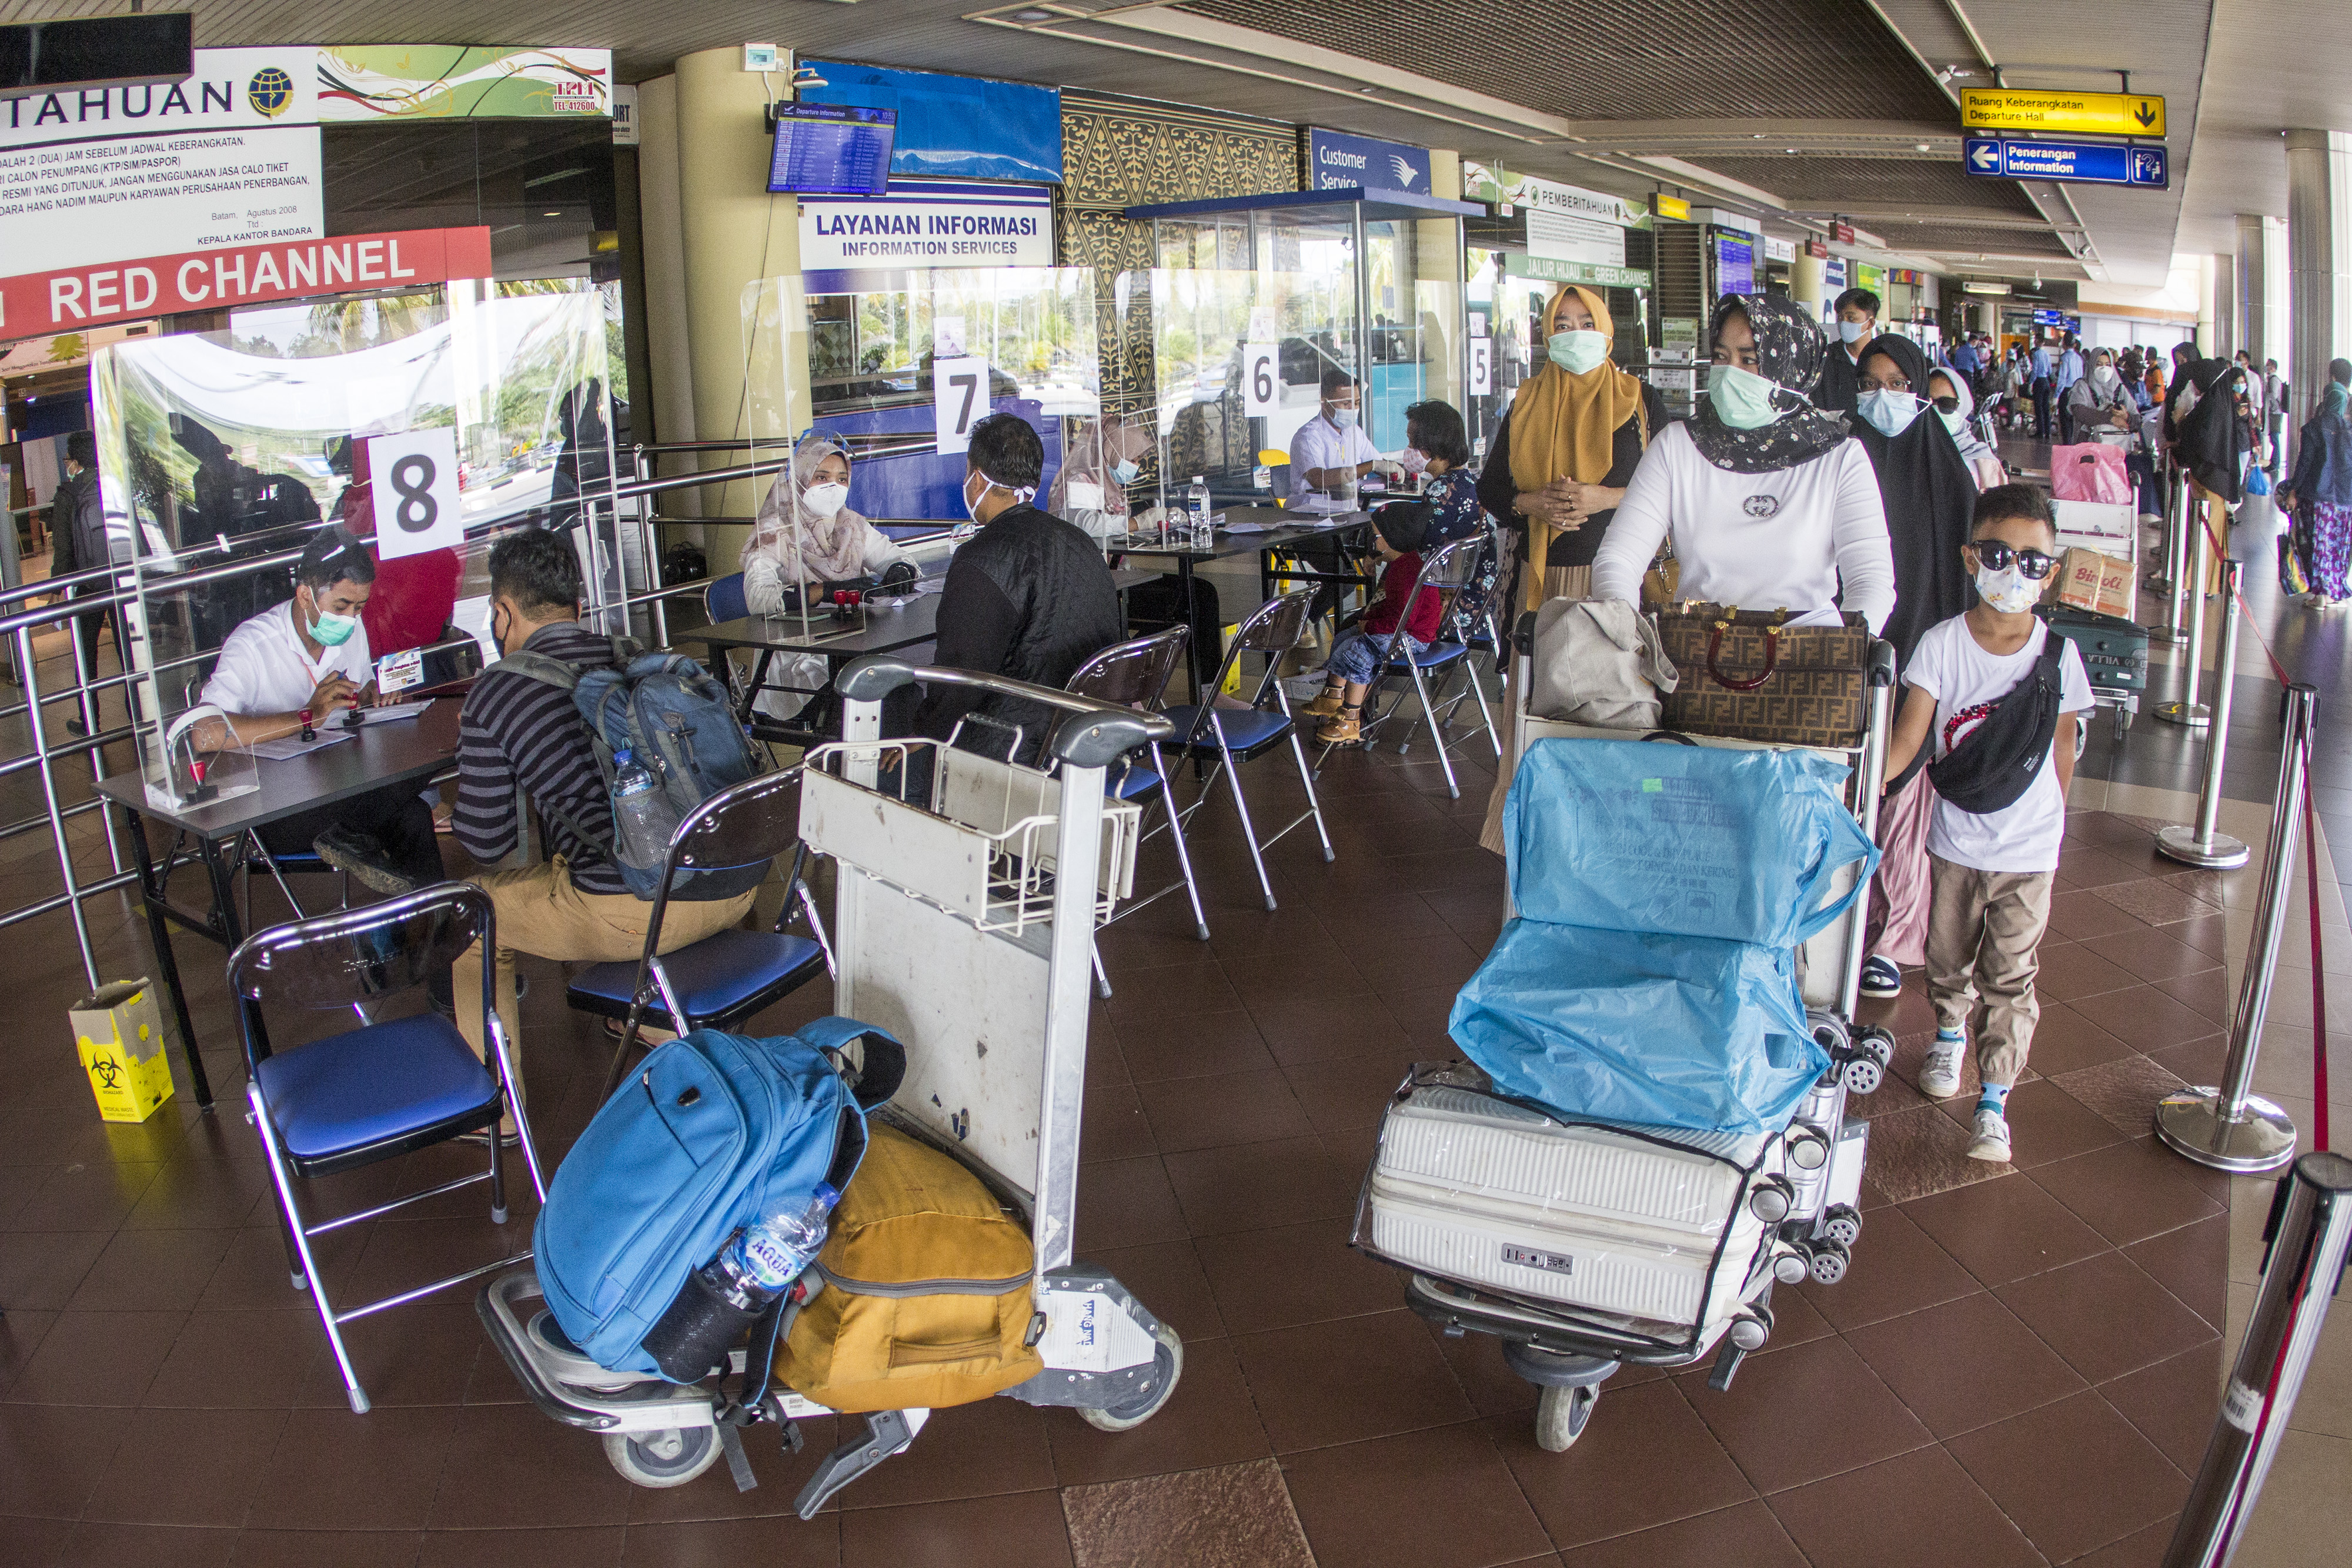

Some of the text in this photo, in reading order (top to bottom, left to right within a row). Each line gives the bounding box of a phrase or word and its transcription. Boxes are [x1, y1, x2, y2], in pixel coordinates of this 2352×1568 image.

[554, 82, 593, 95] TPM
[569, 101, 595, 111] 412600
[796, 108, 896, 120] Departure Information 10:50
[1969, 96, 2084, 111] Ruang Keberangkatan
[1970, 110, 2044, 122] Departure Hall
[29, 155, 35, 165] 2
[38, 152, 63, 166] (DUA)
[65, 151, 83, 161] JAM
[85, 146, 127, 159] SEBELUM
[129, 142, 166, 155] JADWAL
[168, 136, 246, 151] KEBERANGKATAN.
[1320, 146, 1366, 169] Customer
[2008, 146, 2076, 161] Penerangan
[8, 170, 38, 183] CALON
[41, 164, 99, 179] PENUMPANG
[100, 156, 181, 175] (KTP/SIM/PASPOR)
[2009, 159, 2074, 173] Information
[2, 162, 289, 200] RESMI YANG DITUNJUK, JANGAN MENGGUNAKAN JASA CALO TIKET
[1321, 172, 1357, 190] Service
[27, 200, 53, 212] HANG
[55, 196, 86, 209] NADIM
[89, 192, 127, 205] MAUPUN
[130, 186, 180, 200] KARYAWAN
[182, 181, 241, 195] PERUSAHAAN
[243, 176, 310, 190] PENERBANGAN,
[1542, 190, 1613, 216] PEMBERITAHUAN
[212, 206, 298, 221] Batam, Agustus 2008
[817, 214, 1037, 236] LAYANAN INFORMASI
[197, 227, 312, 245] KEPALA KANTOR BANDARA
[842, 240, 1018, 256] INFORMATION SERVICES
[1527, 259, 1581, 280] JALUR HIJAU
[1595, 266, 1651, 287] GREEN CHANNEL
[50, 266, 158, 323] RED
[176, 239, 415, 303] CHANNEL
[1476, 349, 1486, 385] 5
[1254, 356, 1272, 404] 6
[949, 374, 977, 434] 7
[391, 454, 437, 533] 8
[2087, 654, 2120, 666] VILLA
[751, 1238, 793, 1277] AQUA
